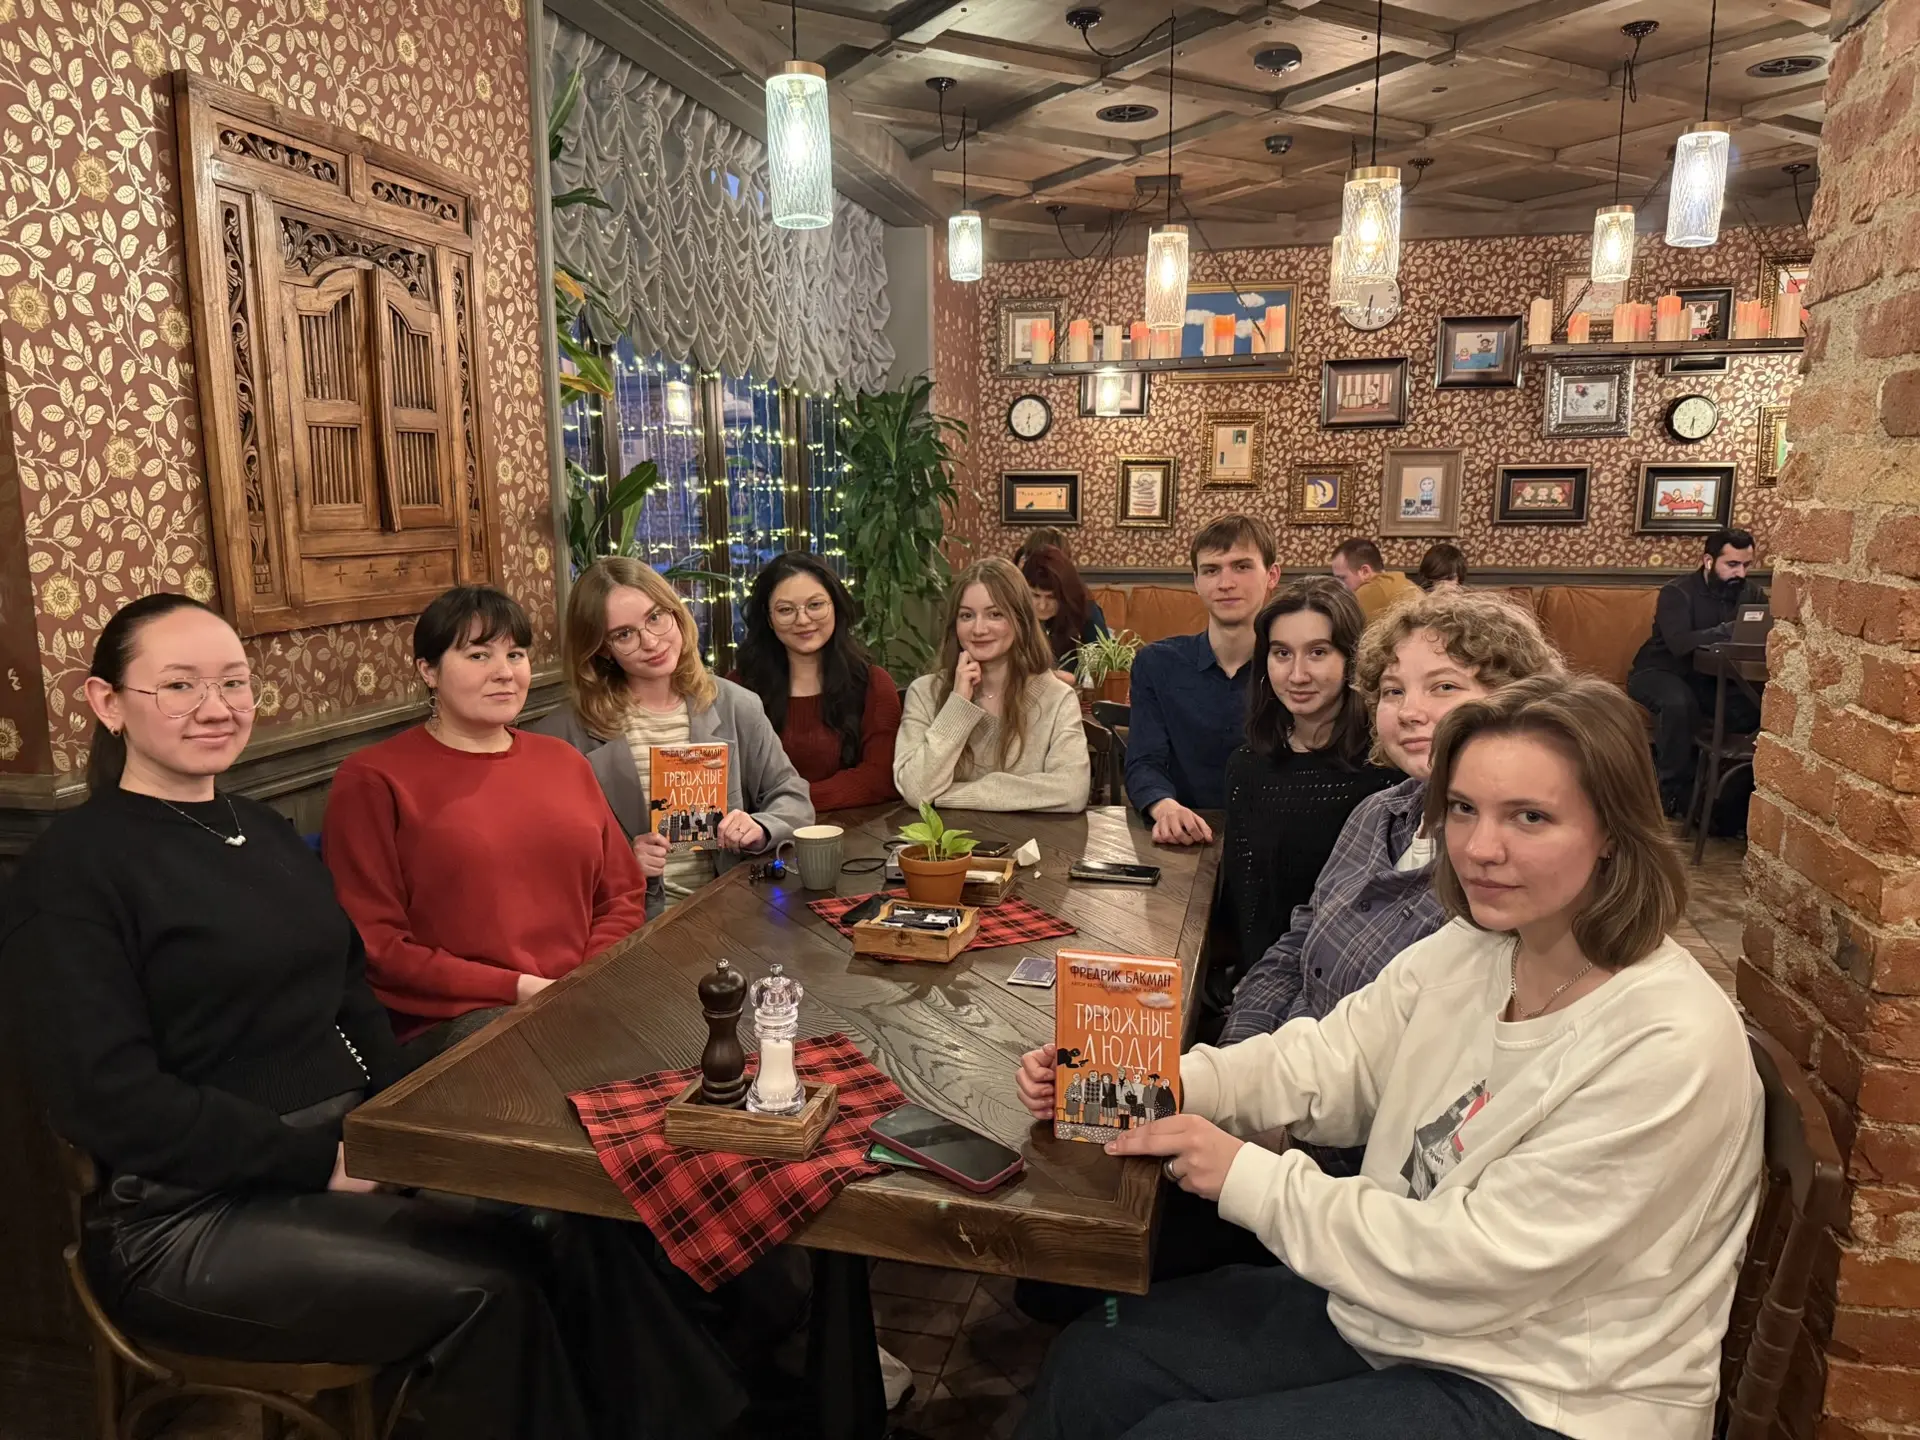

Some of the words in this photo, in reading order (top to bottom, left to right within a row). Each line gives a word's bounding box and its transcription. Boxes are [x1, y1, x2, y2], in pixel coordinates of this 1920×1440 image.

[664, 769, 723, 787] ТРЕВОЖНЫЕ
[669, 786, 718, 808] ЛЮДИ
[1069, 965, 1122, 983] ФРЕДРИК
[1125, 970, 1171, 988] БАКМАН
[1074, 1003, 1173, 1039] ТРЕВОЖНЫЕ
[1082, 1033, 1163, 1075] ЛЮДИ
